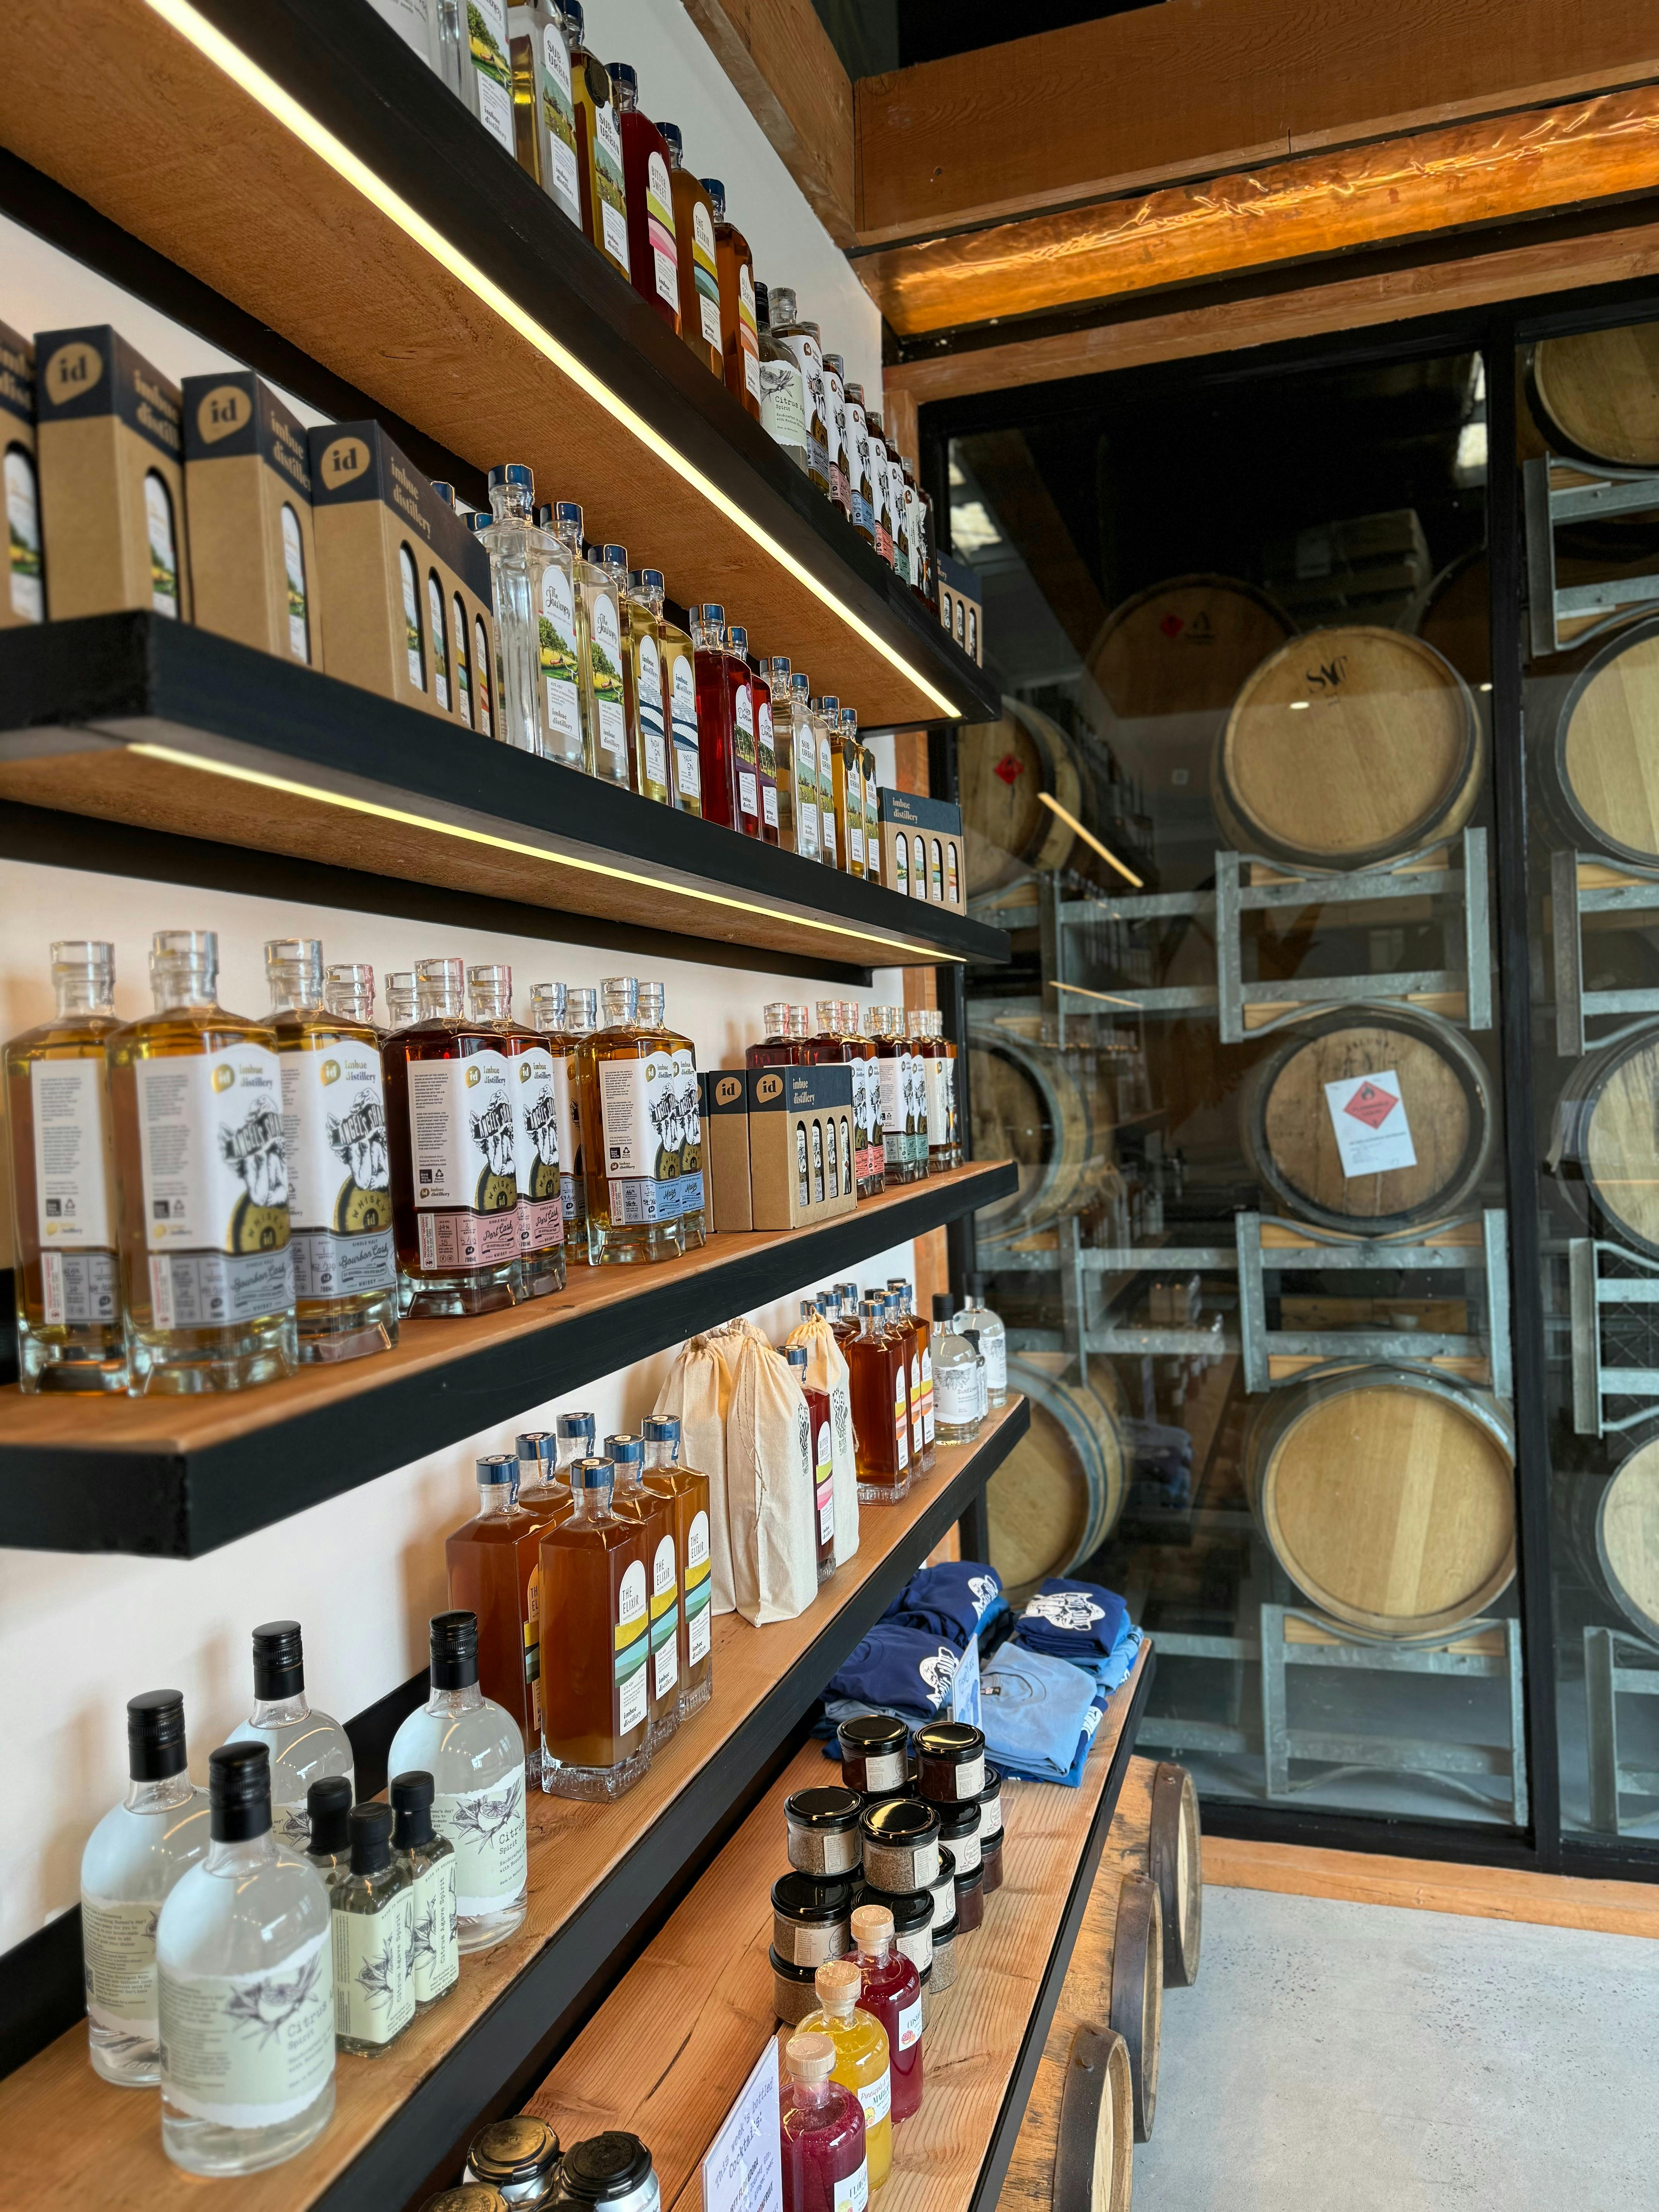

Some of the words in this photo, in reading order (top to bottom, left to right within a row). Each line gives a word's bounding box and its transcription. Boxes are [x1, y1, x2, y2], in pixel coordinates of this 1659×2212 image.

[548, 57, 569, 88] URBAN
[484, 106, 500, 125] imbue
[485, 117, 507, 142] distillery
[600, 125, 620, 155] URBAN
[556, 166, 568, 184] imbue
[651, 165, 666, 185] BITTER
[556, 175, 573, 199] distillery
[653, 177, 666, 199] SWEET
[696, 215, 704, 229] THE
[607, 231, 619, 247] imbue
[697, 229, 709, 247] ELIXIR
[608, 240, 623, 261] distillery
[60, 356, 88, 383] id
[134, 369, 179, 427] imbue
[775, 396, 798, 408] Citrus
[210, 398, 237, 424] id
[271, 411, 304, 460] imbue
[332, 447, 358, 472] id
[390, 457, 419, 500] imbue
[393, 484, 431, 539] distillery
[550, 586, 558, 599] The
[545, 589, 570, 619] Journey
[597, 617, 617, 645] Journey
[642, 654, 654, 667] imbue
[643, 665, 658, 678] distillery
[676, 674, 688, 686] imbue
[677, 684, 692, 697] distillery
[552, 708, 567, 721] imbue
[553, 718, 572, 732] distillery
[603, 728, 615, 740] imbue
[604, 737, 620, 750] distillery
[893, 797, 910, 809] imbue
[894, 809, 918, 824] distillery
[239, 1063, 264, 1074] imbue
[326, 1065, 337, 1078] id
[345, 1060, 367, 1070] imbue
[484, 1066, 500, 1074] imbue
[522, 1066, 529, 1077] id
[648, 1068, 654, 1077] id
[241, 1077, 273, 1089] distillery
[346, 1072, 376, 1084] distillery
[470, 1071, 478, 1081] id
[484, 1076, 506, 1086] distillery
[534, 1071, 551, 1081] distillery
[658, 1072, 672, 1080] distillery
[793, 1078, 808, 1090] imbue
[721, 1083, 735, 1096] id
[762, 1080, 776, 1093] id
[793, 1092, 815, 1106] distillery
[479, 1111, 501, 1138] ANGEL'S
[530, 1104, 547, 1130] ANGEL'S
[338, 1114, 369, 1144] ANGEL'S
[539, 1170, 558, 1187] WHISKY
[488, 1181, 513, 1200] WHISKY
[352, 1195, 386, 1219] WHISKY
[498, 1194, 506, 1206] id
[367, 1213, 376, 1226] id
[536, 1214, 548, 1227] Port
[547, 1206, 558, 1218] Cask
[483, 1229, 499, 1241] Port
[498, 1220, 514, 1235] Cask
[339, 1248, 373, 1269] Bourbon
[372, 1242, 389, 1257] Cask
[231, 1271, 268, 1293] Bourbon
[268, 1261, 286, 1277] Cask
[359, 1279, 376, 1287] WHISKY
[819, 1436, 828, 1449] BITTER
[820, 1446, 828, 1458] SWEET
[692, 1541, 704, 1559] ELIXIR
[657, 1567, 670, 1586] ELIXIR
[622, 1586, 632, 1601] THE
[623, 1595, 639, 1614] ELIXIR
[692, 1645, 706, 1660] distillery
[658, 1671, 670, 1685] imbue
[659, 1676, 673, 1692] distillery
[623, 1705, 637, 1719] imbue
[624, 1710, 641, 1728] distillery
[499, 1819, 525, 1844] Citrus
[500, 1839, 517, 1854] Spirit
[500, 1847, 522, 1866] Handcrafted
[500, 1865, 510, 1873] with
[288, 2001, 327, 2037] Citrus
[288, 2028, 314, 2050] Spirit
[861, 2083, 883, 2100] Pineapple
[715, 2155, 729, 2189] This
[732, 2112, 750, 2152] week's
[752, 2076, 773, 2114] bottled
